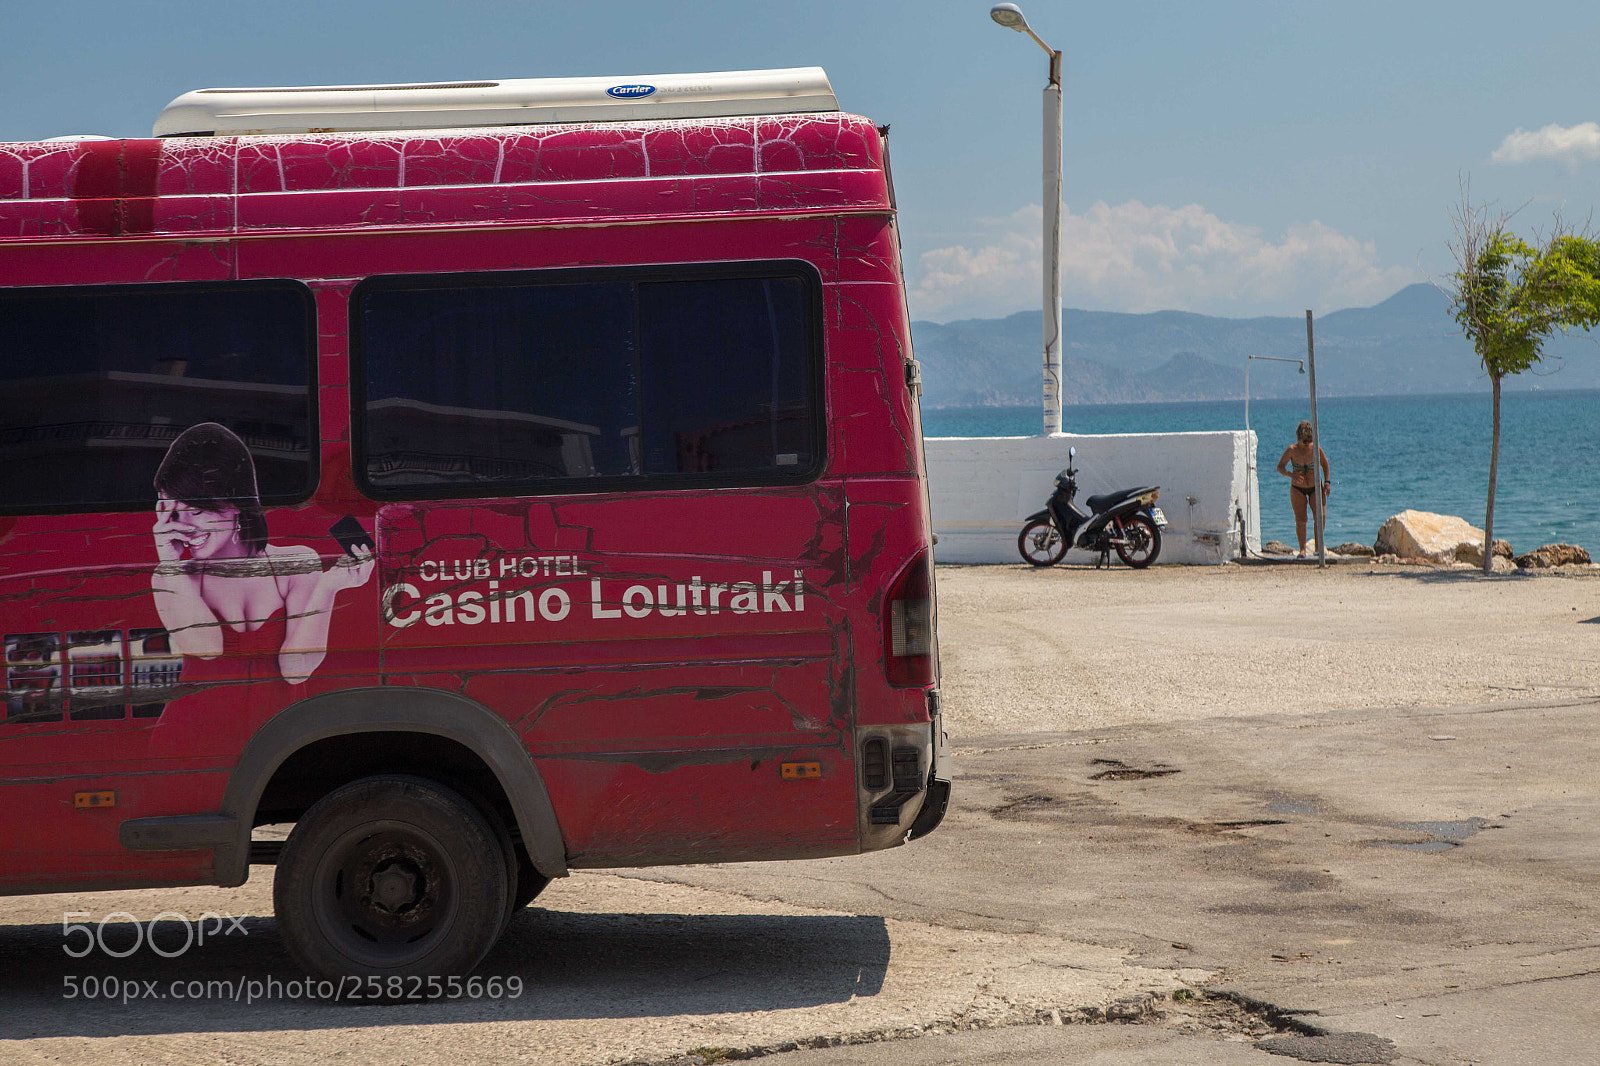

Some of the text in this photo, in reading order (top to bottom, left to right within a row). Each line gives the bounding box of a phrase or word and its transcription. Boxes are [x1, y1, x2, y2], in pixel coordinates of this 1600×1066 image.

[612, 85, 651, 95] Carrier
[419, 555, 588, 582] CLUB HOTEL
[382, 570, 806, 628] Casino Loutraki
